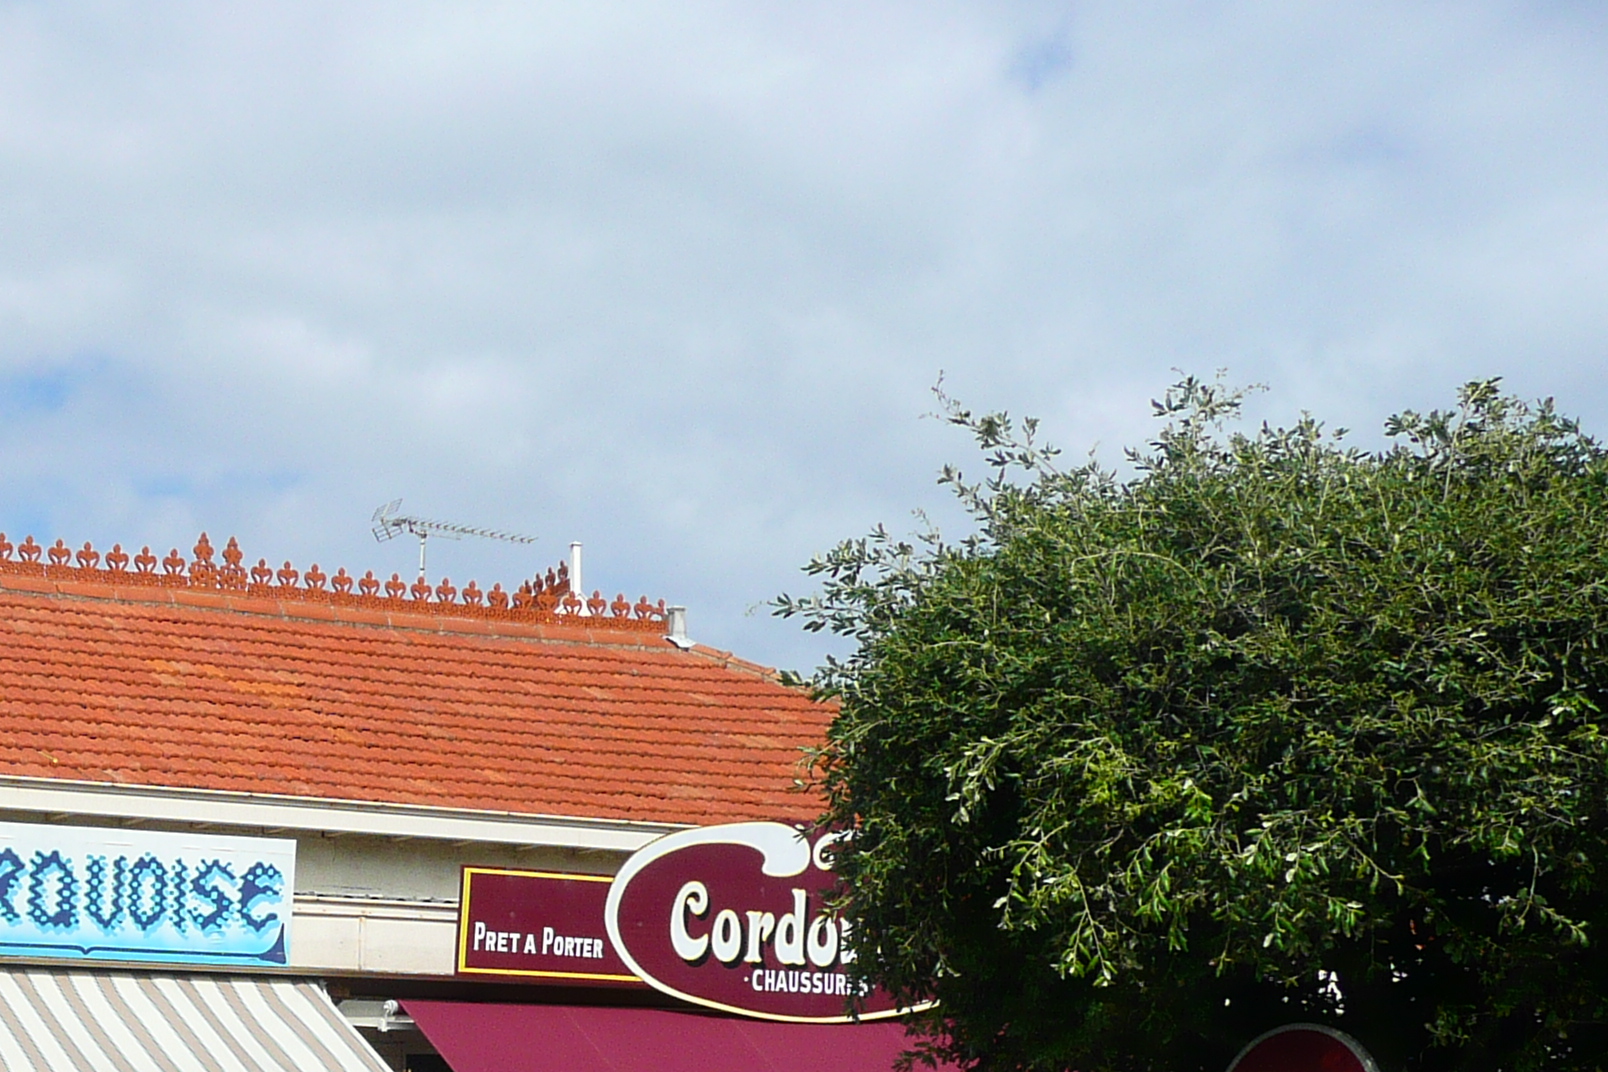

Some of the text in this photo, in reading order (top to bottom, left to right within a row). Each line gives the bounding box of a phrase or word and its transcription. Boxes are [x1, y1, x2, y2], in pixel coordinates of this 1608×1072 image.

[473, 921, 604, 959] PRET A PORTER
